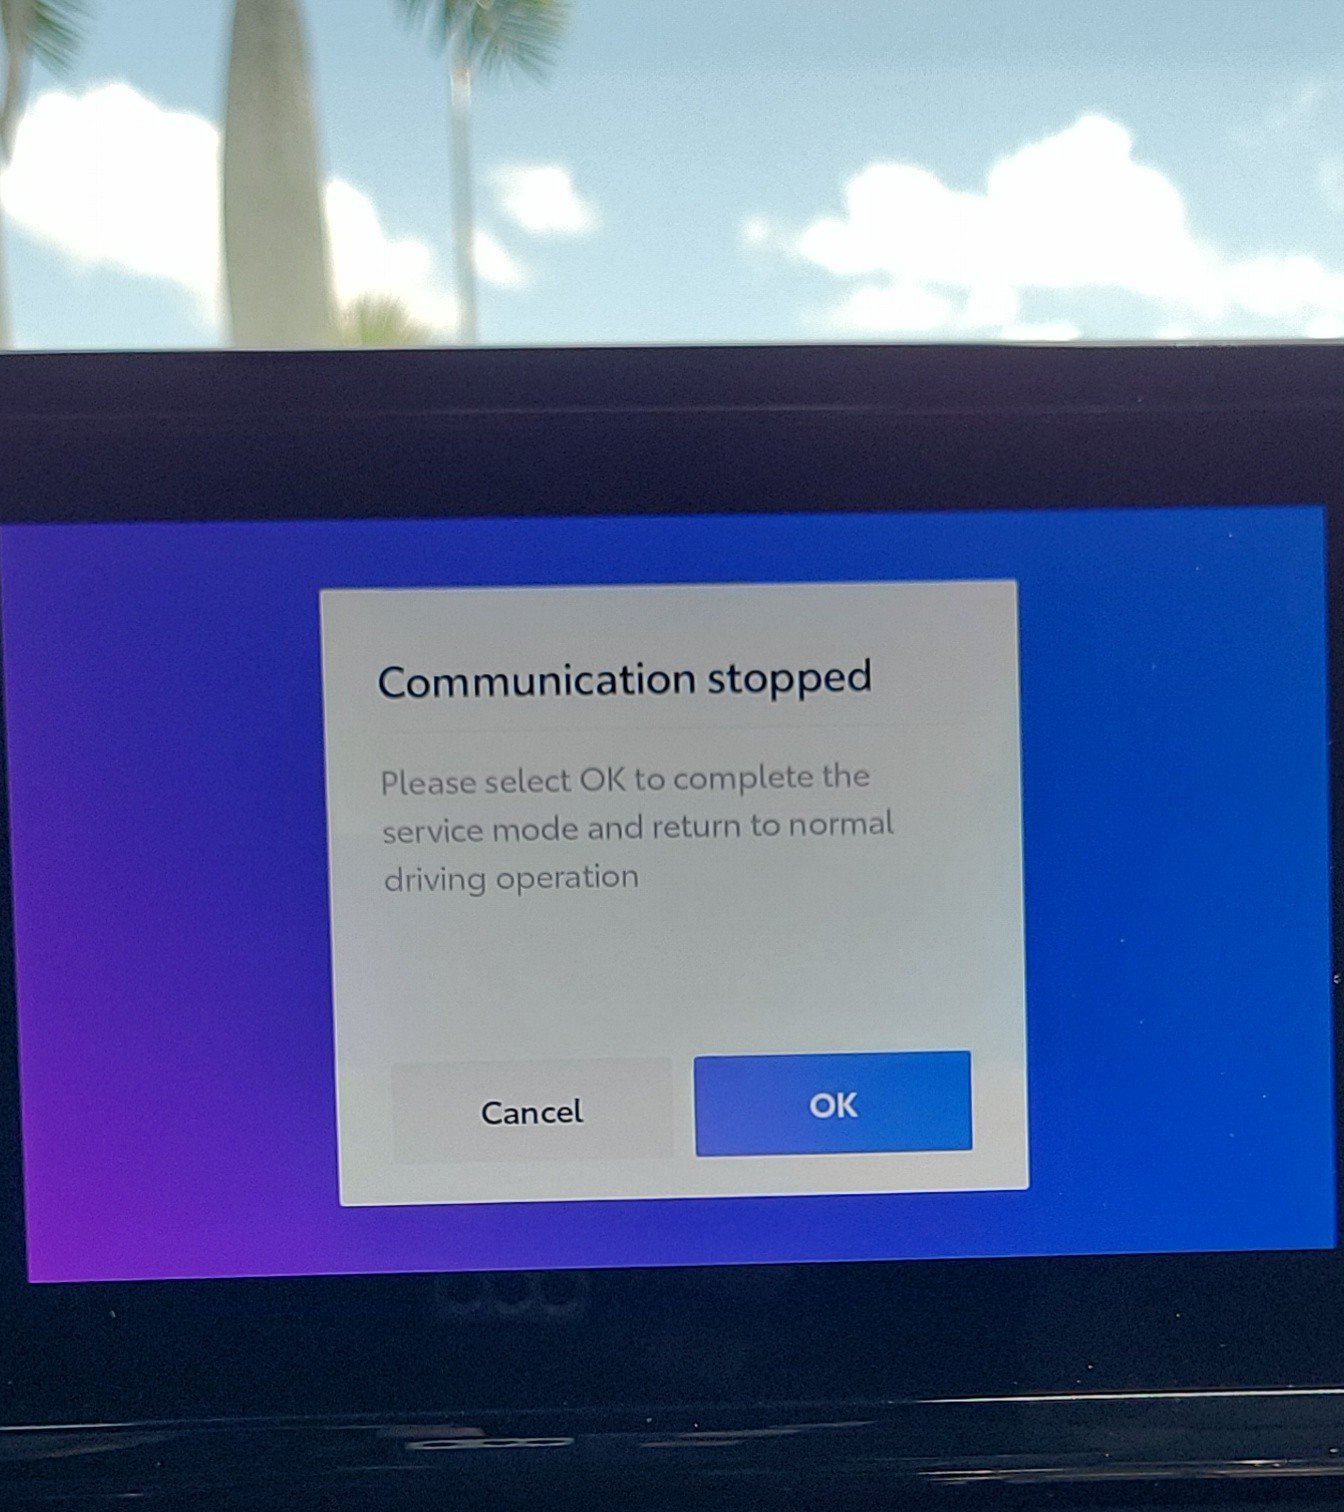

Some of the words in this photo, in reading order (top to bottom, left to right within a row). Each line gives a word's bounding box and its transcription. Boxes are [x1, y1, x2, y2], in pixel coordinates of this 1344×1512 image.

[378, 662, 697, 699] Communication
[707, 658, 872, 702] stopped
[381, 769, 477, 797] Please
[484, 767, 571, 795] select
[579, 766, 625, 793] OK
[635, 769, 666, 792] to
[674, 763, 814, 796] complete
[823, 762, 871, 789] the
[383, 817, 485, 845] service
[493, 815, 579, 843] mode
[588, 813, 644, 841] and
[653, 815, 741, 841] return
[751, 814, 781, 838] to
[790, 809, 894, 838] normal
[384, 867, 487, 898] driving
[496, 862, 640, 897] operation
[481, 1098, 584, 1126] Cancel
[809, 1092, 859, 1119] OK
